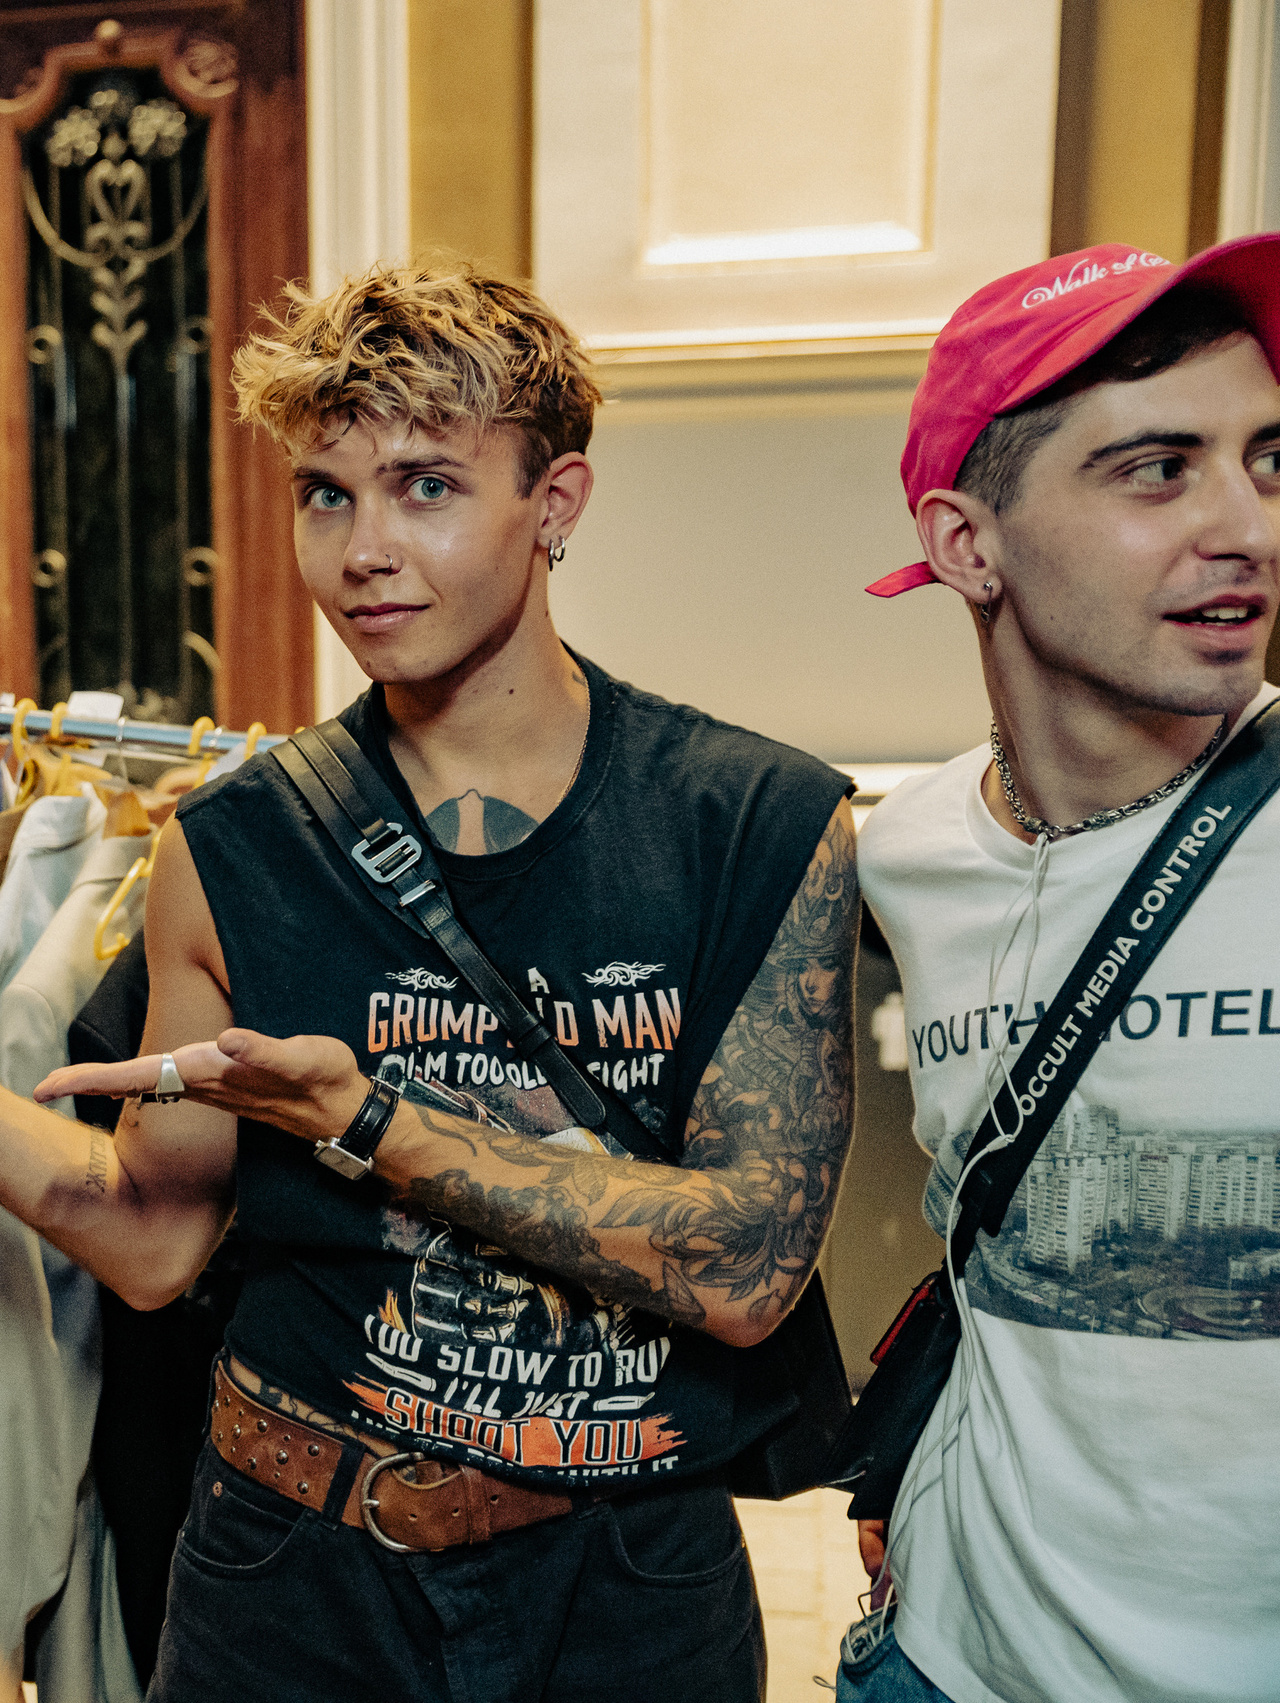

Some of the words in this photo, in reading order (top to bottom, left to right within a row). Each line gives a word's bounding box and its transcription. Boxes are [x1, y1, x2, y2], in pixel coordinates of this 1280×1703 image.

[1022, 258, 1109, 309] Walk
[1111, 253, 1138, 275] of
[527, 967, 550, 994] A
[1020, 1013, 1083, 1116] OCCULT
[1076, 935, 1140, 1019] MEDIA
[1130, 803, 1232, 931] CONTROL
[368, 992, 515, 1054] GRUMP
[592, 988, 682, 1050] MAN
[912, 1000, 1047, 1068] YOUTH
[1099, 988, 1280, 1042] OTEL
[443, 1377, 502, 1418] I'LL
[511, 1391, 590, 1419] JUST
[568, 1351, 603, 1387] TO
[384, 1386, 531, 1466] SHOOT
[550, 1418, 644, 1467] YOU
